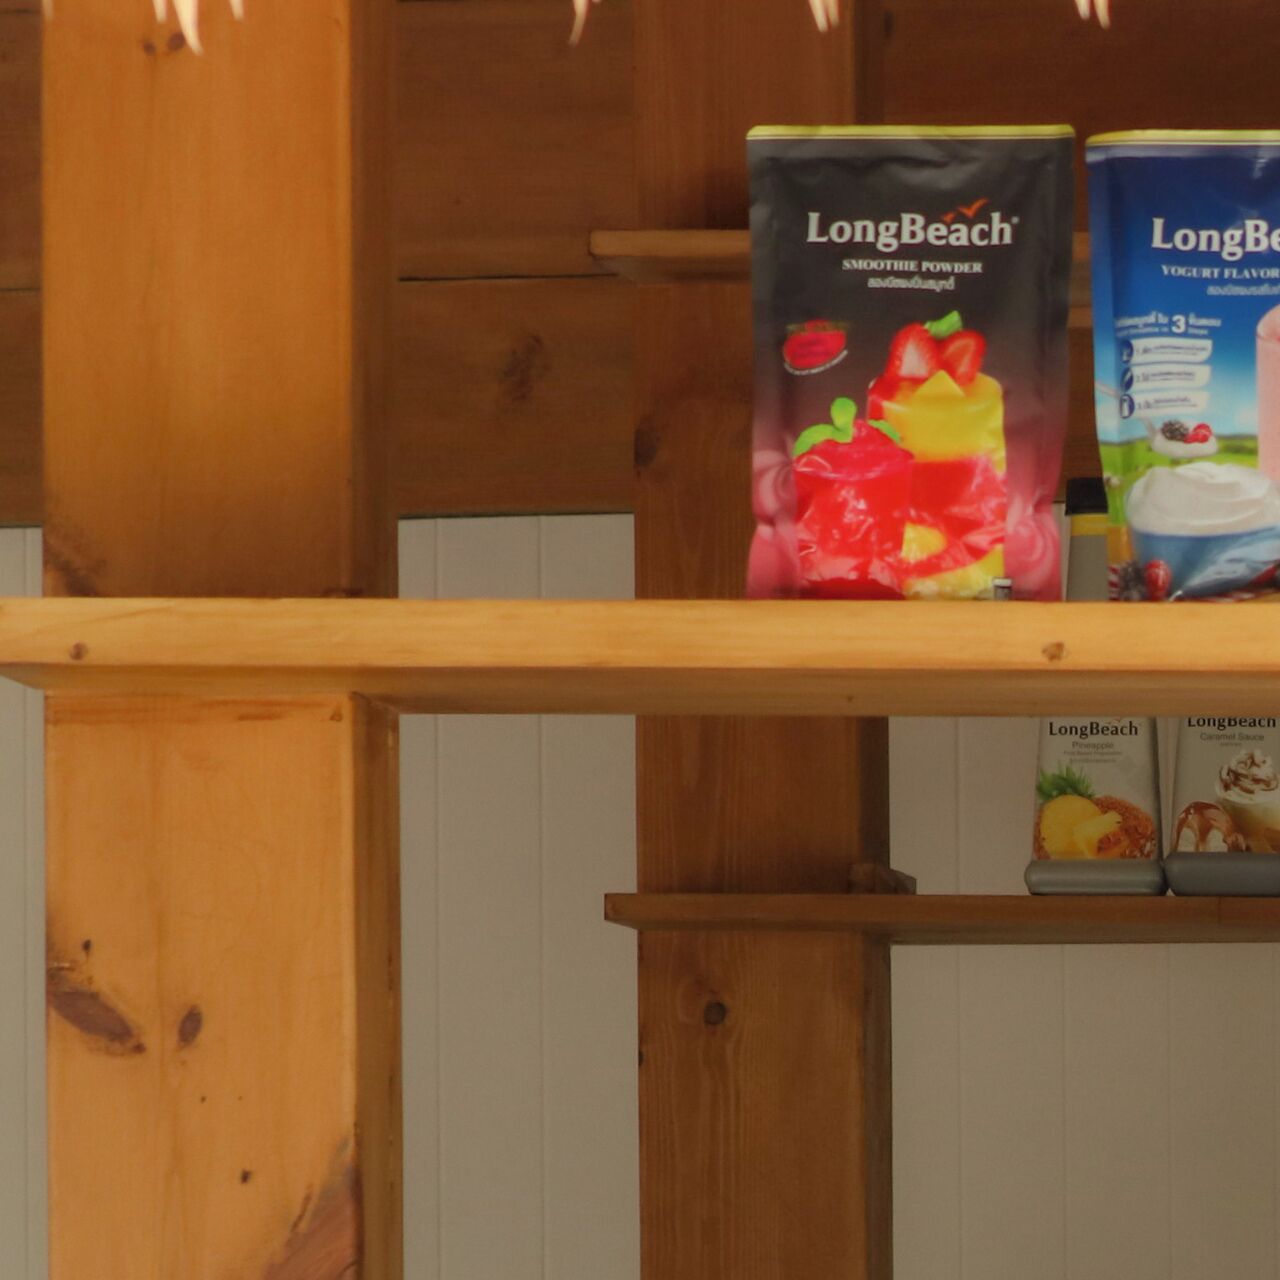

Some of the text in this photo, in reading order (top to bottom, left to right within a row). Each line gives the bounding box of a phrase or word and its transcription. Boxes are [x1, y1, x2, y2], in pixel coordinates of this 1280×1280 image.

[806, 212, 1013, 252] LongBeach
[842, 259, 983, 273] SMOOTHIE POWDER
[1161, 265, 1220, 279] YOGURT
[1223, 266, 1280, 279] FLAVOR
[1171, 314, 1186, 334] 3
[1049, 721, 1138, 739] LongBeach
[1187, 718, 1276, 730] LongBeach
[1200, 732, 1265, 741] Caramel Sauce
[1072, 741, 1115, 750] Pineapple
